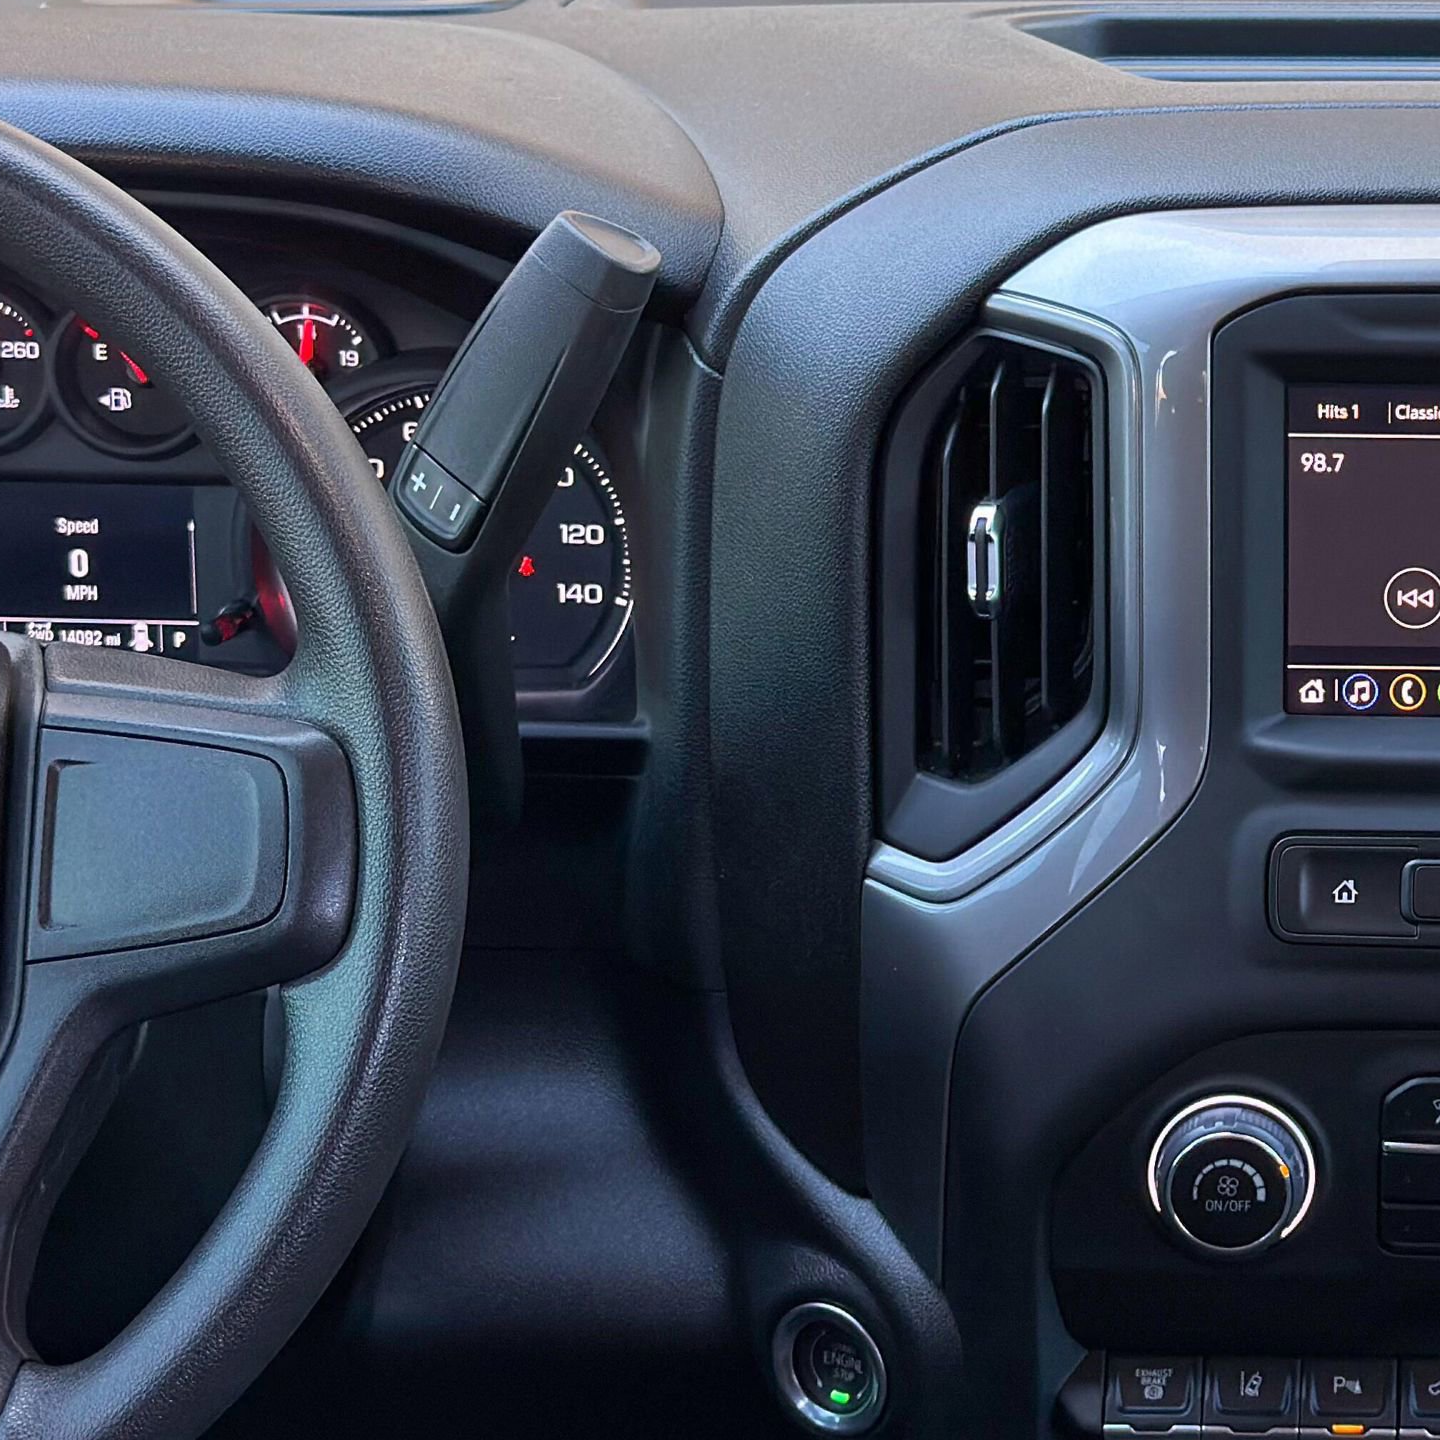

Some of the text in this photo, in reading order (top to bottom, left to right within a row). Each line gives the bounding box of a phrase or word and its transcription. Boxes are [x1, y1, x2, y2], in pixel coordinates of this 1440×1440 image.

[0, 340, 40, 359] 260
[93, 344, 108, 361] E
[339, 350, 359, 367] 19
[1317, 403, 1359, 421] Hits 1
[1300, 453, 1345, 473] 98.7
[55, 517, 99, 536] Speed
[559, 523, 604, 545] 120
[68, 548, 89, 578] 0
[64, 584, 98, 601] MPH
[557, 582, 603, 604] 140
[173, 631, 186, 648] P
[1205, 1199, 1252, 1212] ON/OFF
